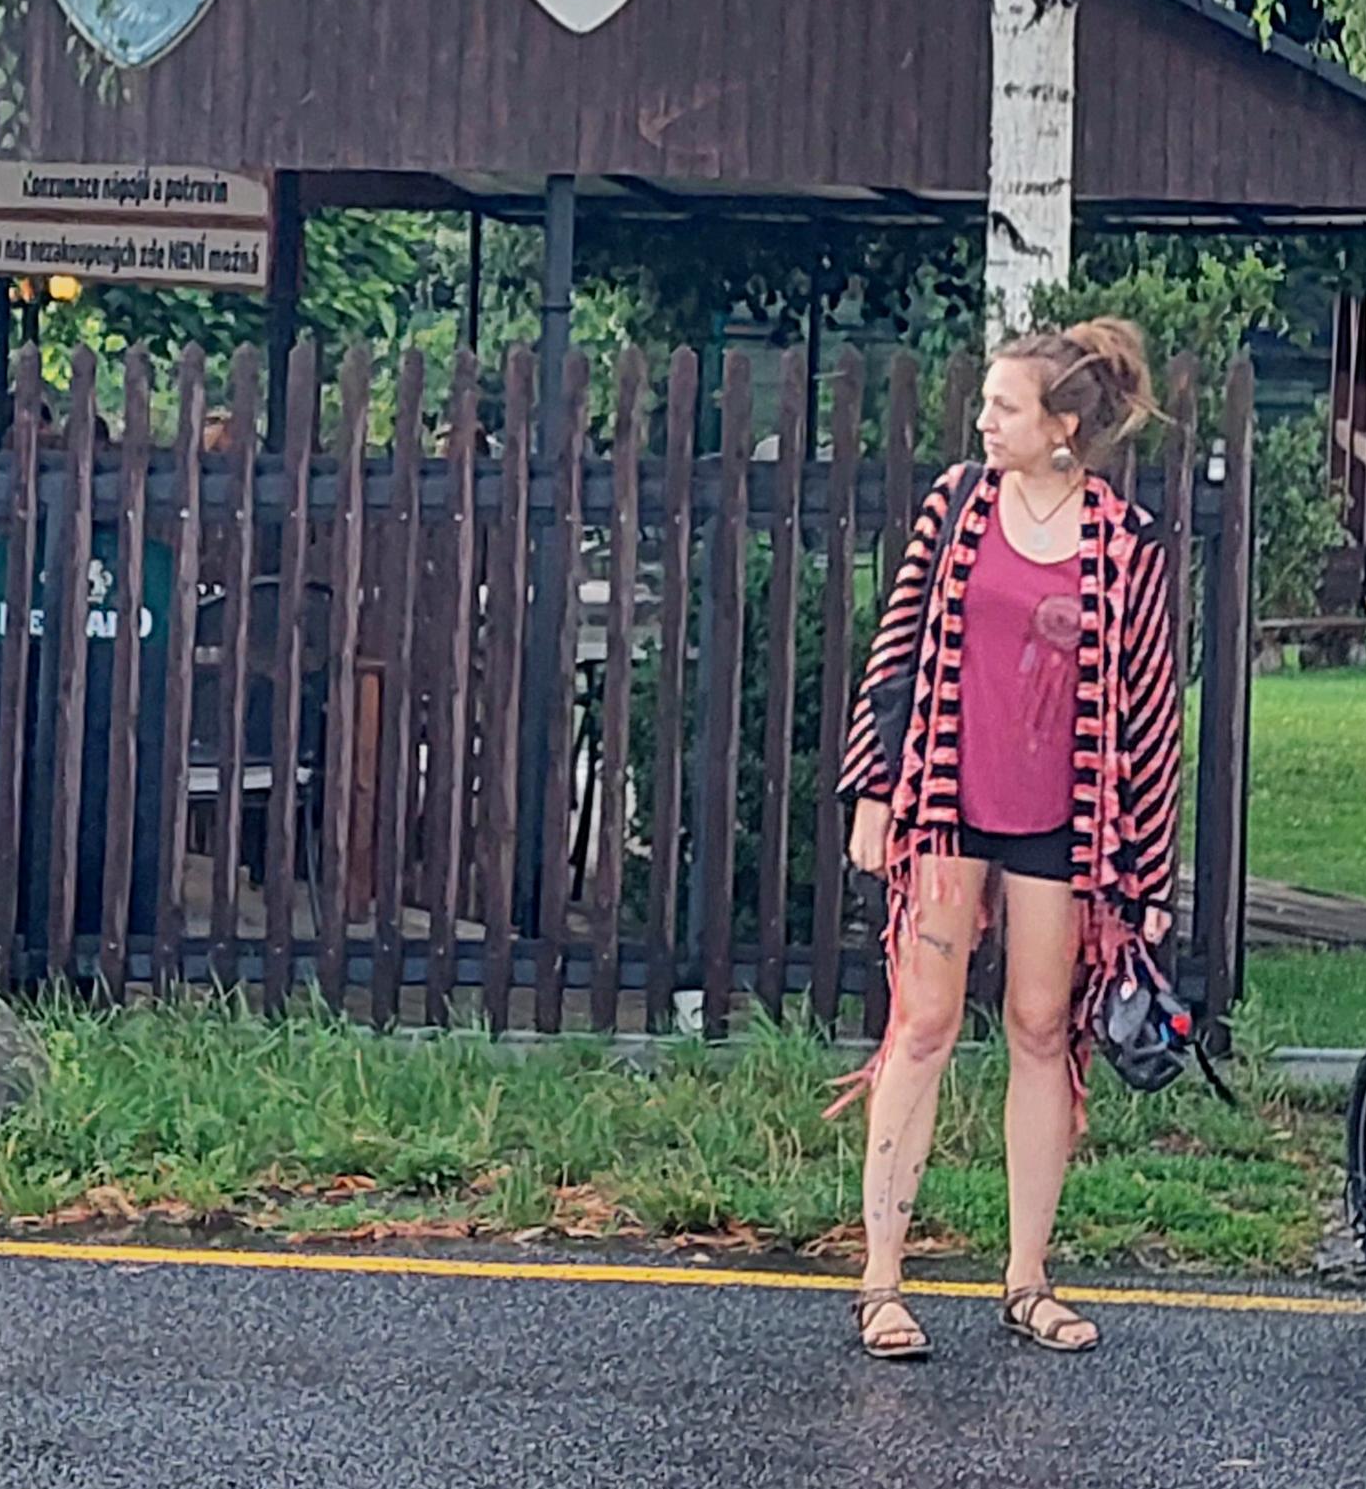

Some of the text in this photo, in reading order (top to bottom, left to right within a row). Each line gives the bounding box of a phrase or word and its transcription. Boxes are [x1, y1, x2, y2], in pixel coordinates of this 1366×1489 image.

[153, 178, 162, 201] a
[165, 173, 227, 208] potravin
[5, 232, 27, 262] nás
[139, 238, 165, 269] zde
[168, 232, 206, 271] NENÍ
[209, 241, 259, 275] možná
